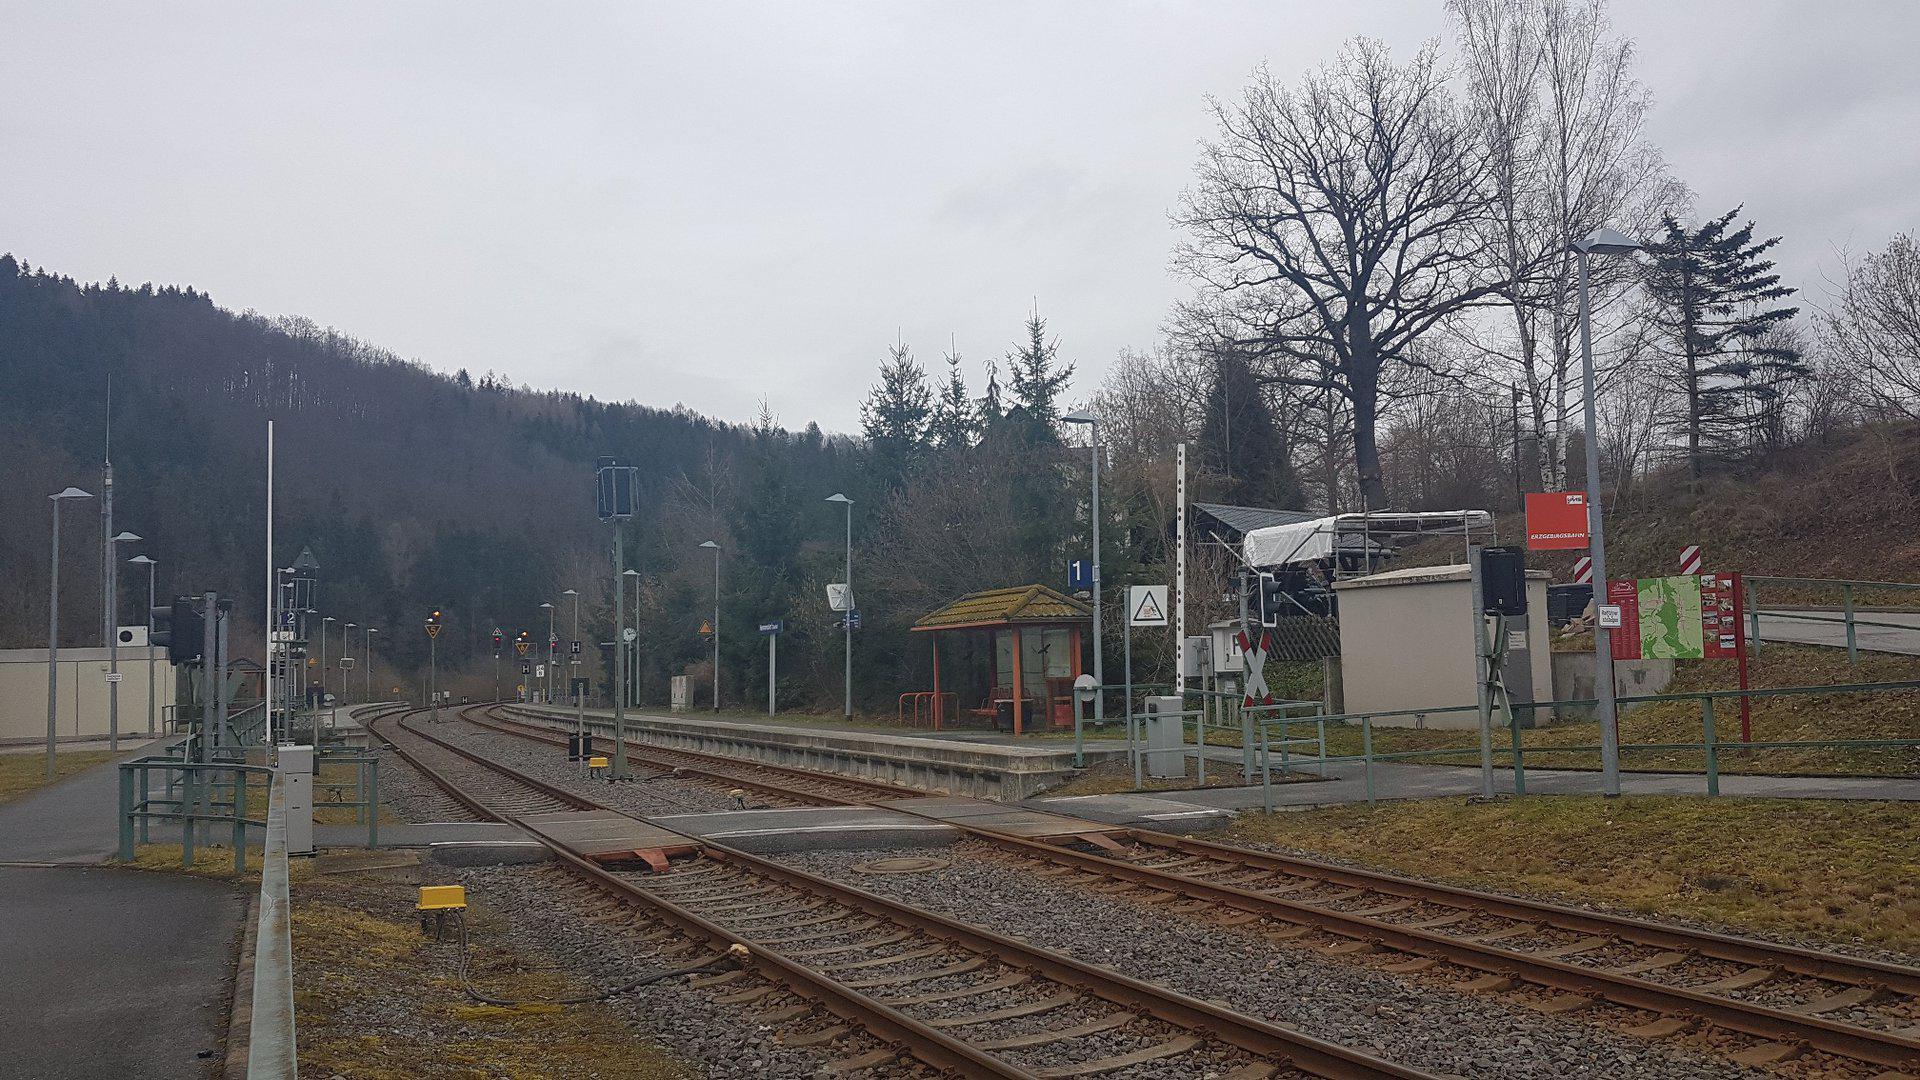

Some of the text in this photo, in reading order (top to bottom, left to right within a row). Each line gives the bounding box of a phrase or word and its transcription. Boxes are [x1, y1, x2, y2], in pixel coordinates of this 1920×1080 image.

[1072, 560, 1081, 581] 1
[287, 612, 295, 624] 2
[571, 642, 581, 653] H
[522, 665, 530, 674] H
[461, 696, 469, 704] H
